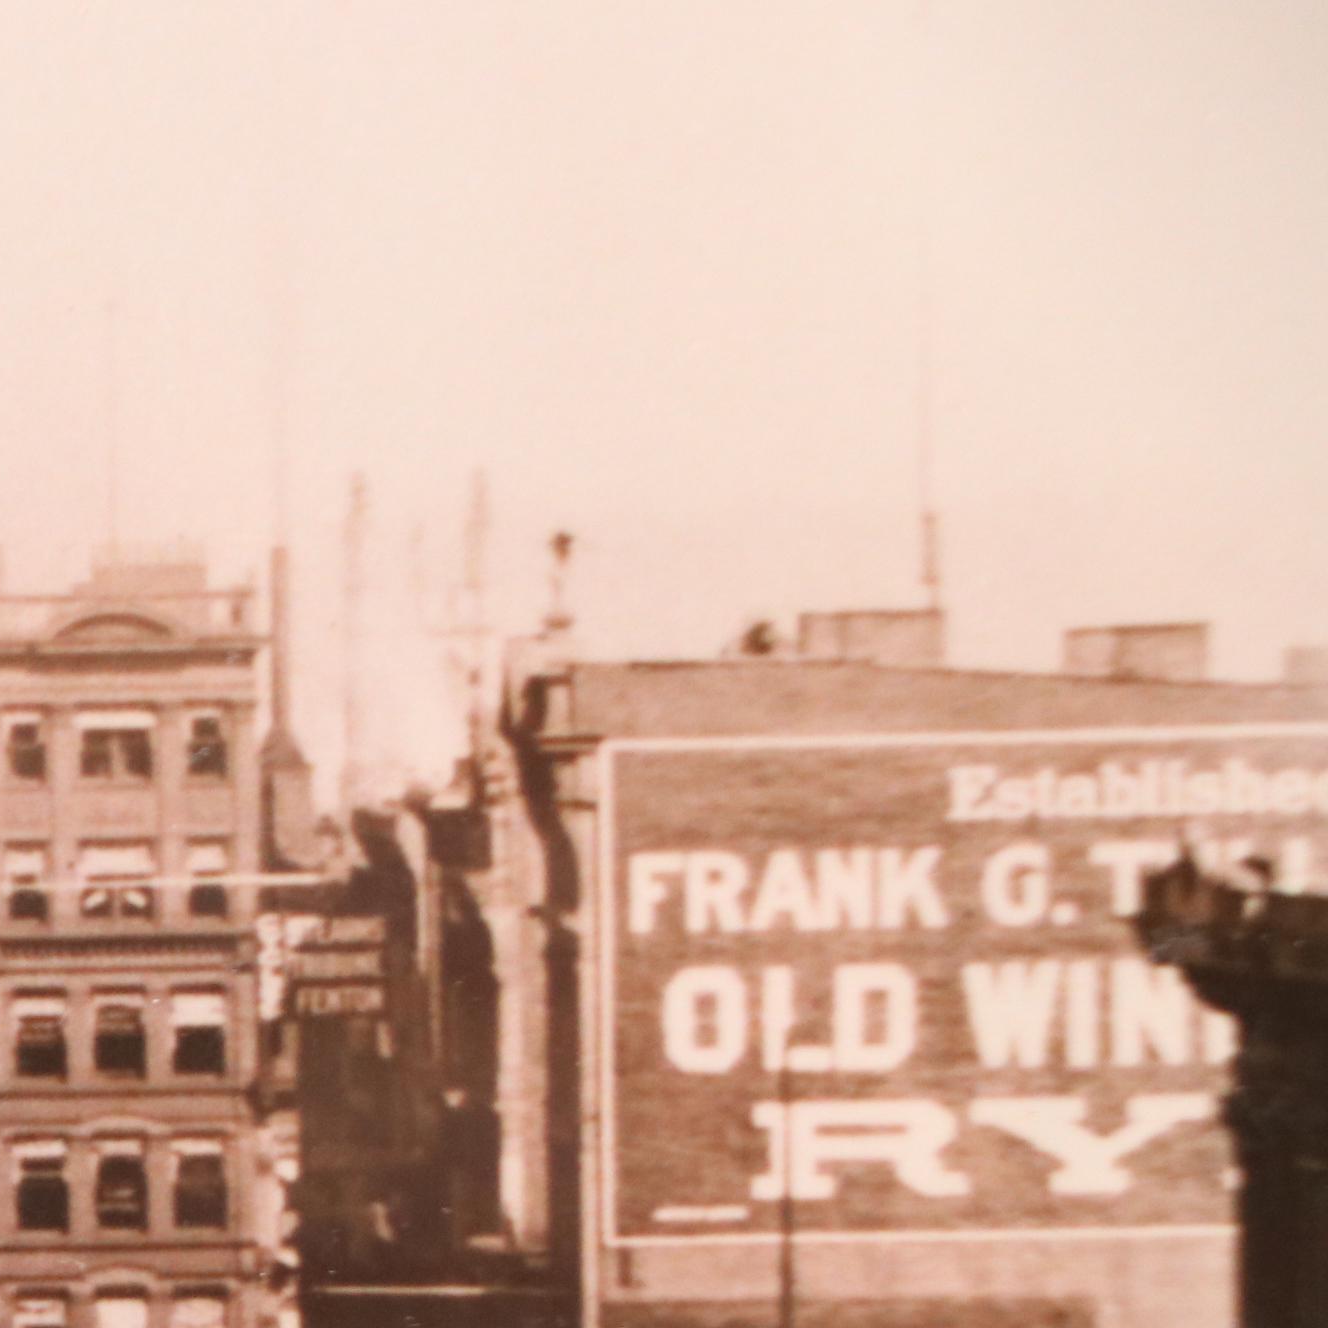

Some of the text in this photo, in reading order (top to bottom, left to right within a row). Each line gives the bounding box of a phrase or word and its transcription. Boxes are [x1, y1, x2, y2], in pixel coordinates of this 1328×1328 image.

[946, 760, 1328, 820] Establishe
[628, 846, 950, 933] FRANK
[981, 843, 1080, 926] G.
[661, 963, 918, 1074] OLD
[749, 1093, 1242, 1200] RY
